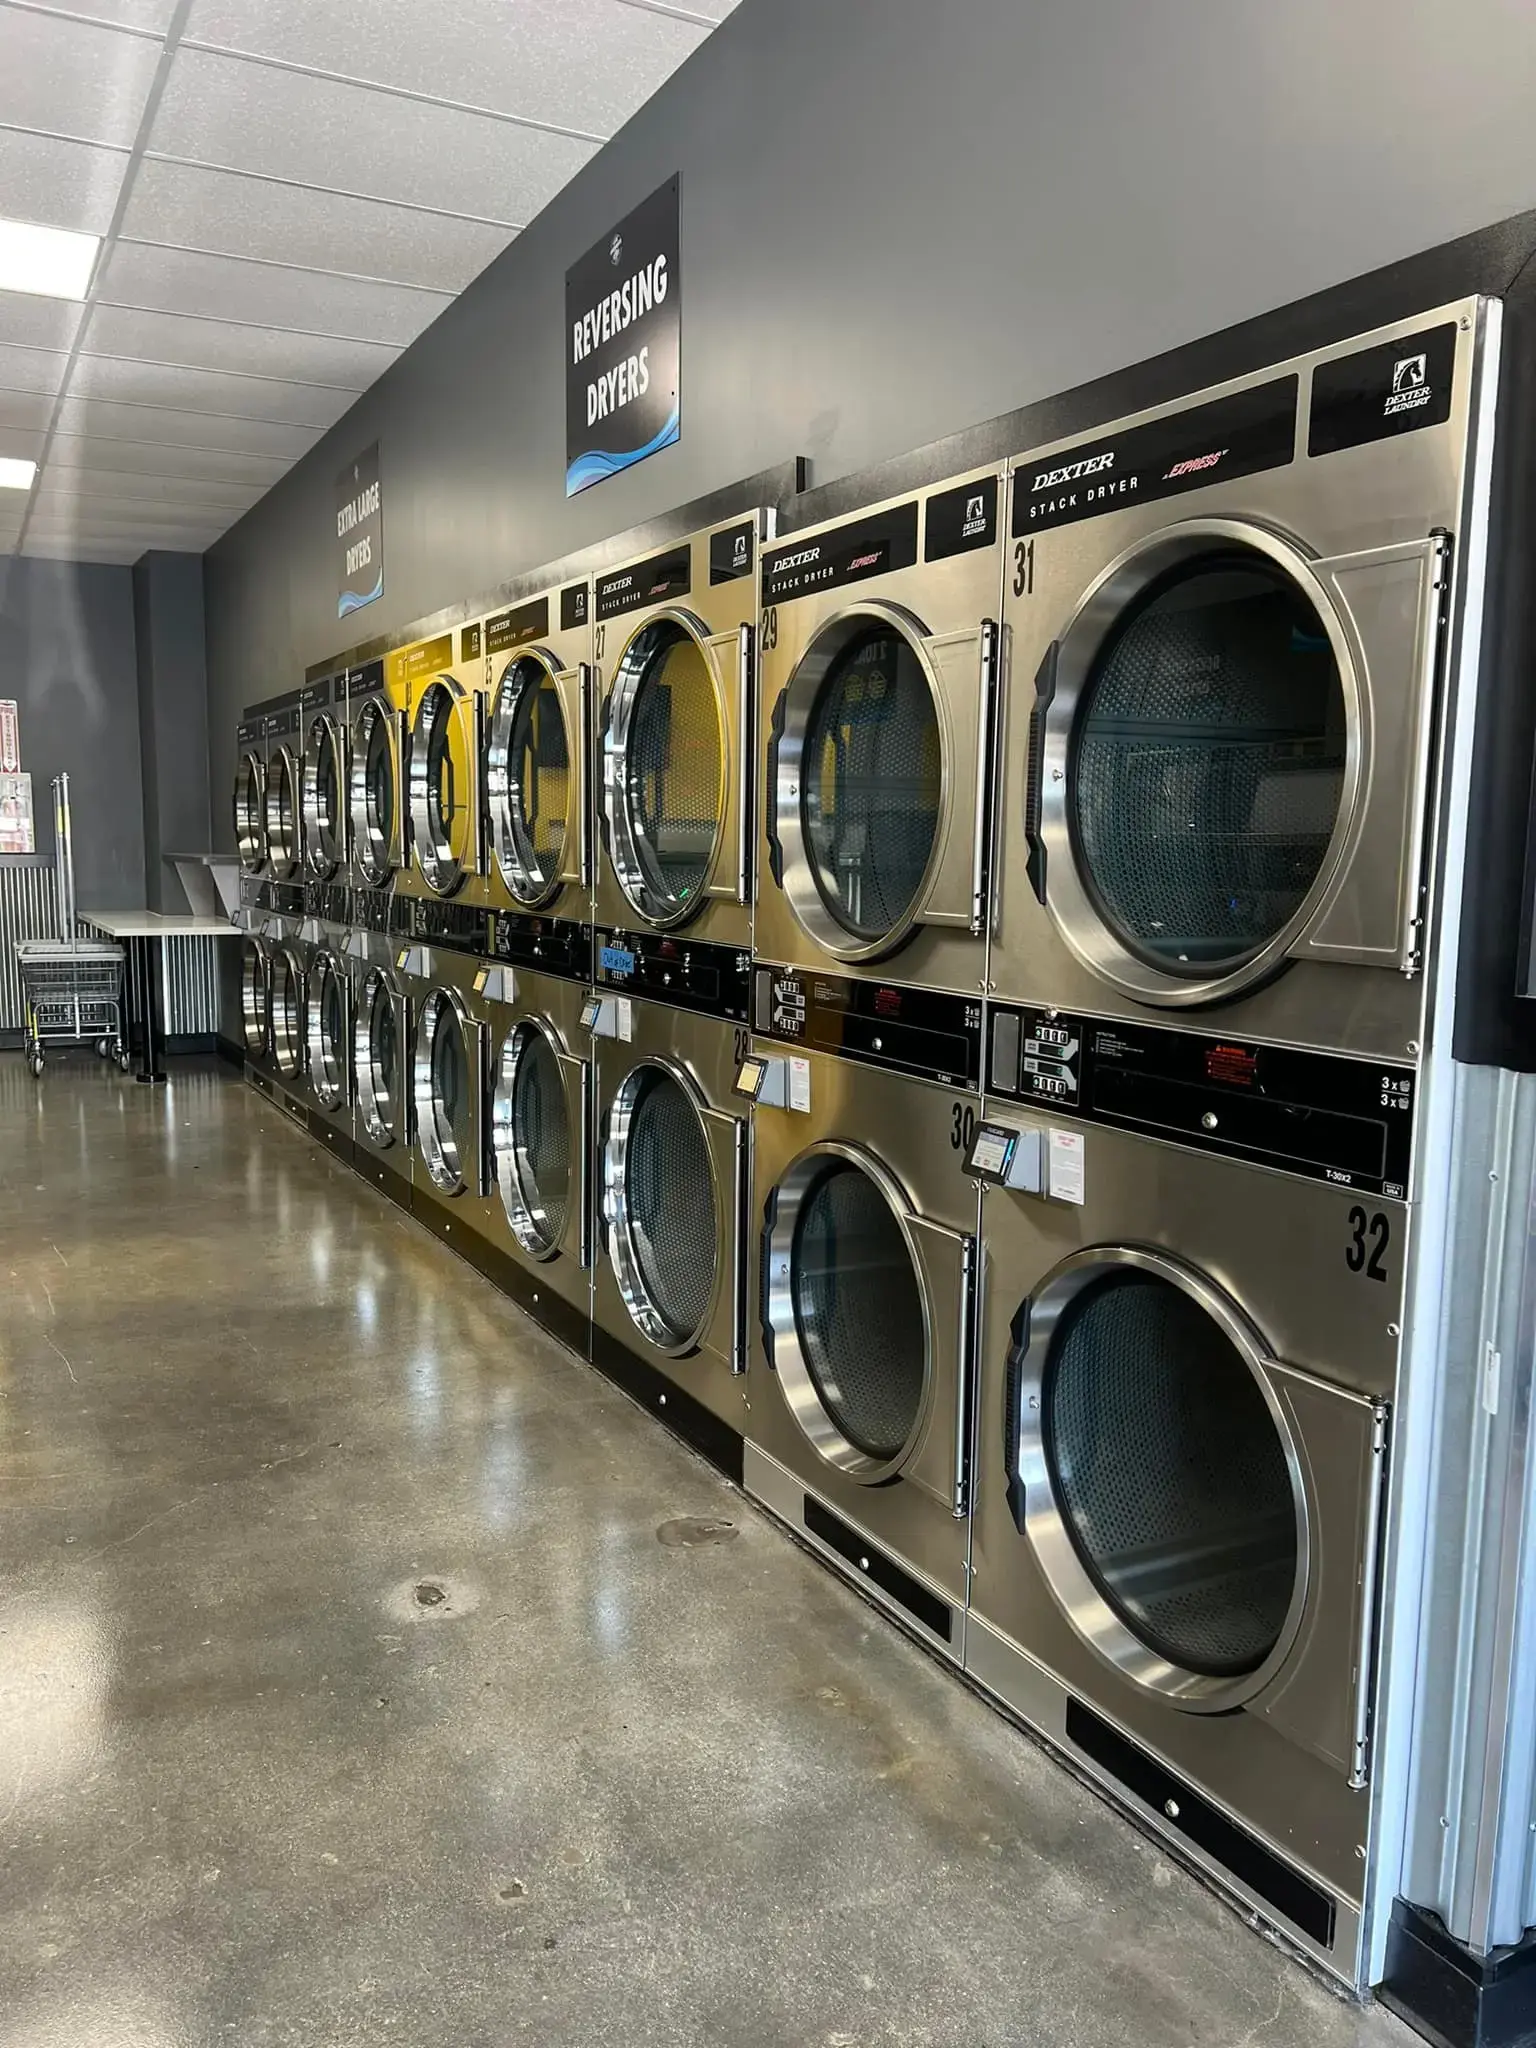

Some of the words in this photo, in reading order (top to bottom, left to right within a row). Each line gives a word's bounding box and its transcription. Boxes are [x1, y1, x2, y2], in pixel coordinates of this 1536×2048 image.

[573, 253, 668, 365] REVERSING
[587, 346, 648, 427] DRYERS
[1383, 395, 1432, 416] LAUNDRY
[1384, 386, 1432, 407] DEXTER
[1031, 452, 1115, 492] DEXTER
[1168, 451, 1222, 478] EXPRESS
[337, 503, 358, 538] EXTRA
[357, 481, 380, 522] LARGE
[1029, 494, 1077, 518] STACK
[1087, 476, 1138, 502] DRYER
[346, 535, 372, 576] DRYERS
[772, 547, 821, 573] DEXTER
[1013, 539, 1034, 597] 31
[602, 576, 633, 596] DEXTER
[771, 577, 800, 593] STACK
[804, 566, 834, 583] DRYER
[595, 624, 606, 660] 27
[762, 606, 778, 651] 29
[1380, 1093, 1388, 1106] 3
[1381, 1076, 1390, 1089] 3
[950, 1102, 975, 1152] 30
[1346, 1205, 1390, 1283] 32
